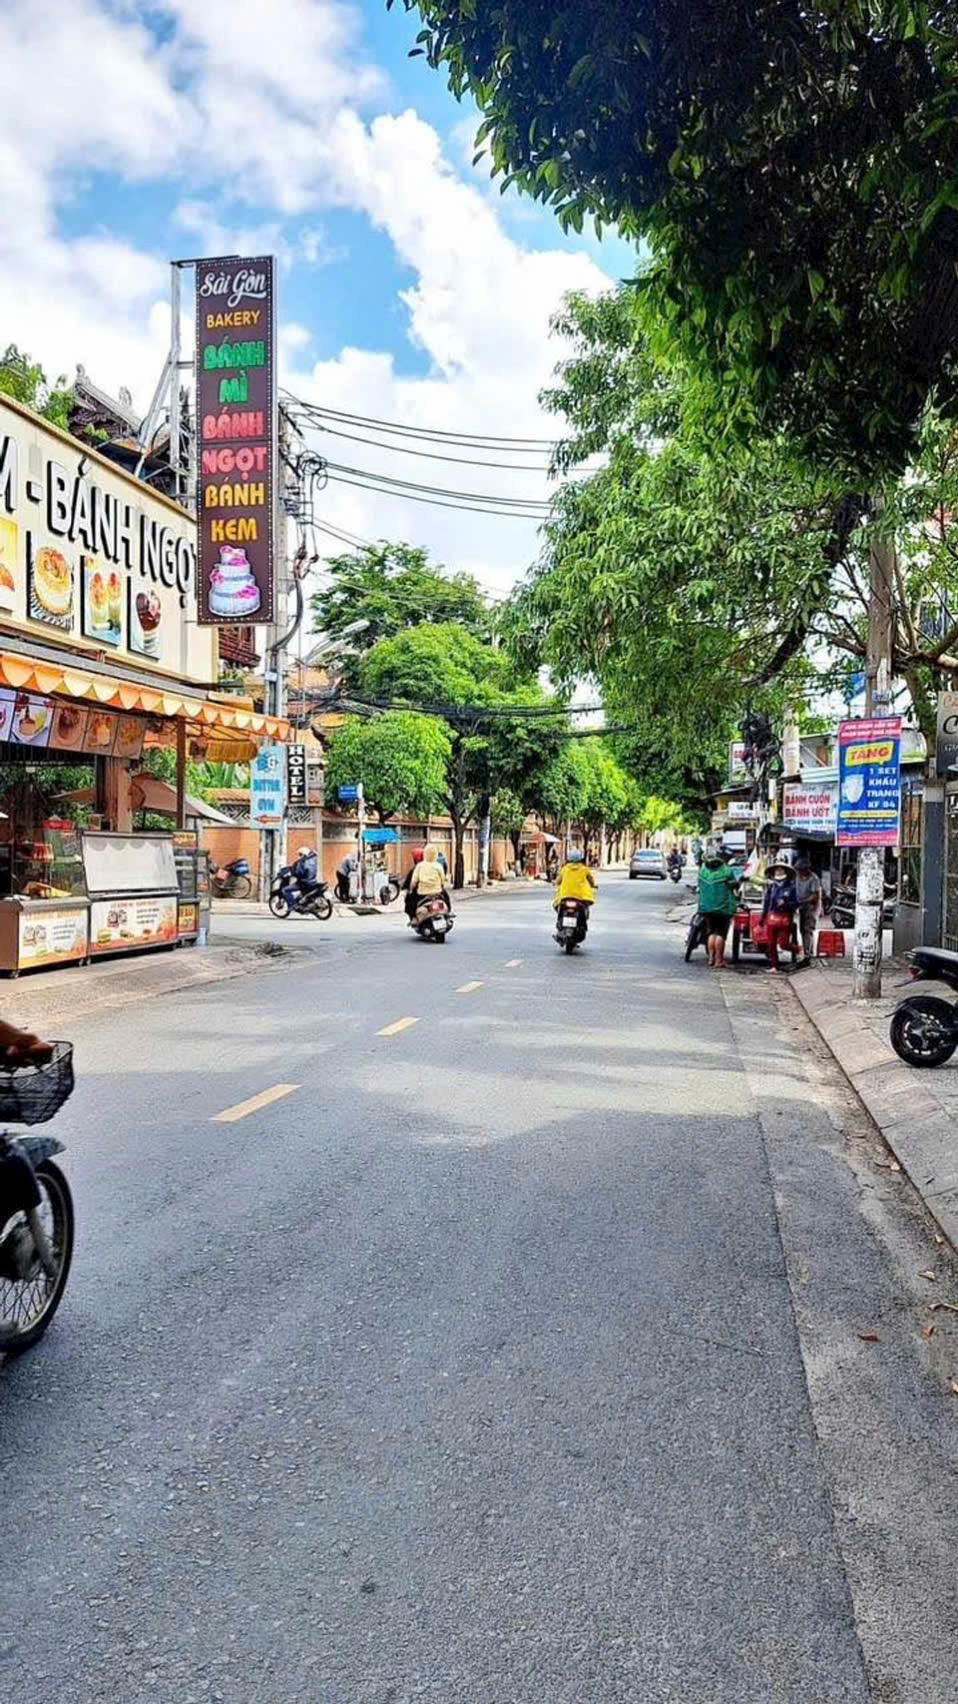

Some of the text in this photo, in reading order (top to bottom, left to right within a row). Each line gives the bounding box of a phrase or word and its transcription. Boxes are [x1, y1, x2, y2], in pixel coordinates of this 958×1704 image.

[200, 269, 267, 307] Sài Gòn
[206, 310, 261, 329] BAKERY
[203, 336, 265, 370] BÁNH
[219, 371, 249, 404] MÌ
[202, 408, 265, 440] BÁNH
[202, 446, 267, 481] NGỌT
[205, 476, 265, 508] BÁNH
[47, 457, 134, 569] BÁNH
[140, 513, 197, 609] NGỌ
[211, 518, 258, 544] KEM
[289, 746, 304, 796] HOTEL
